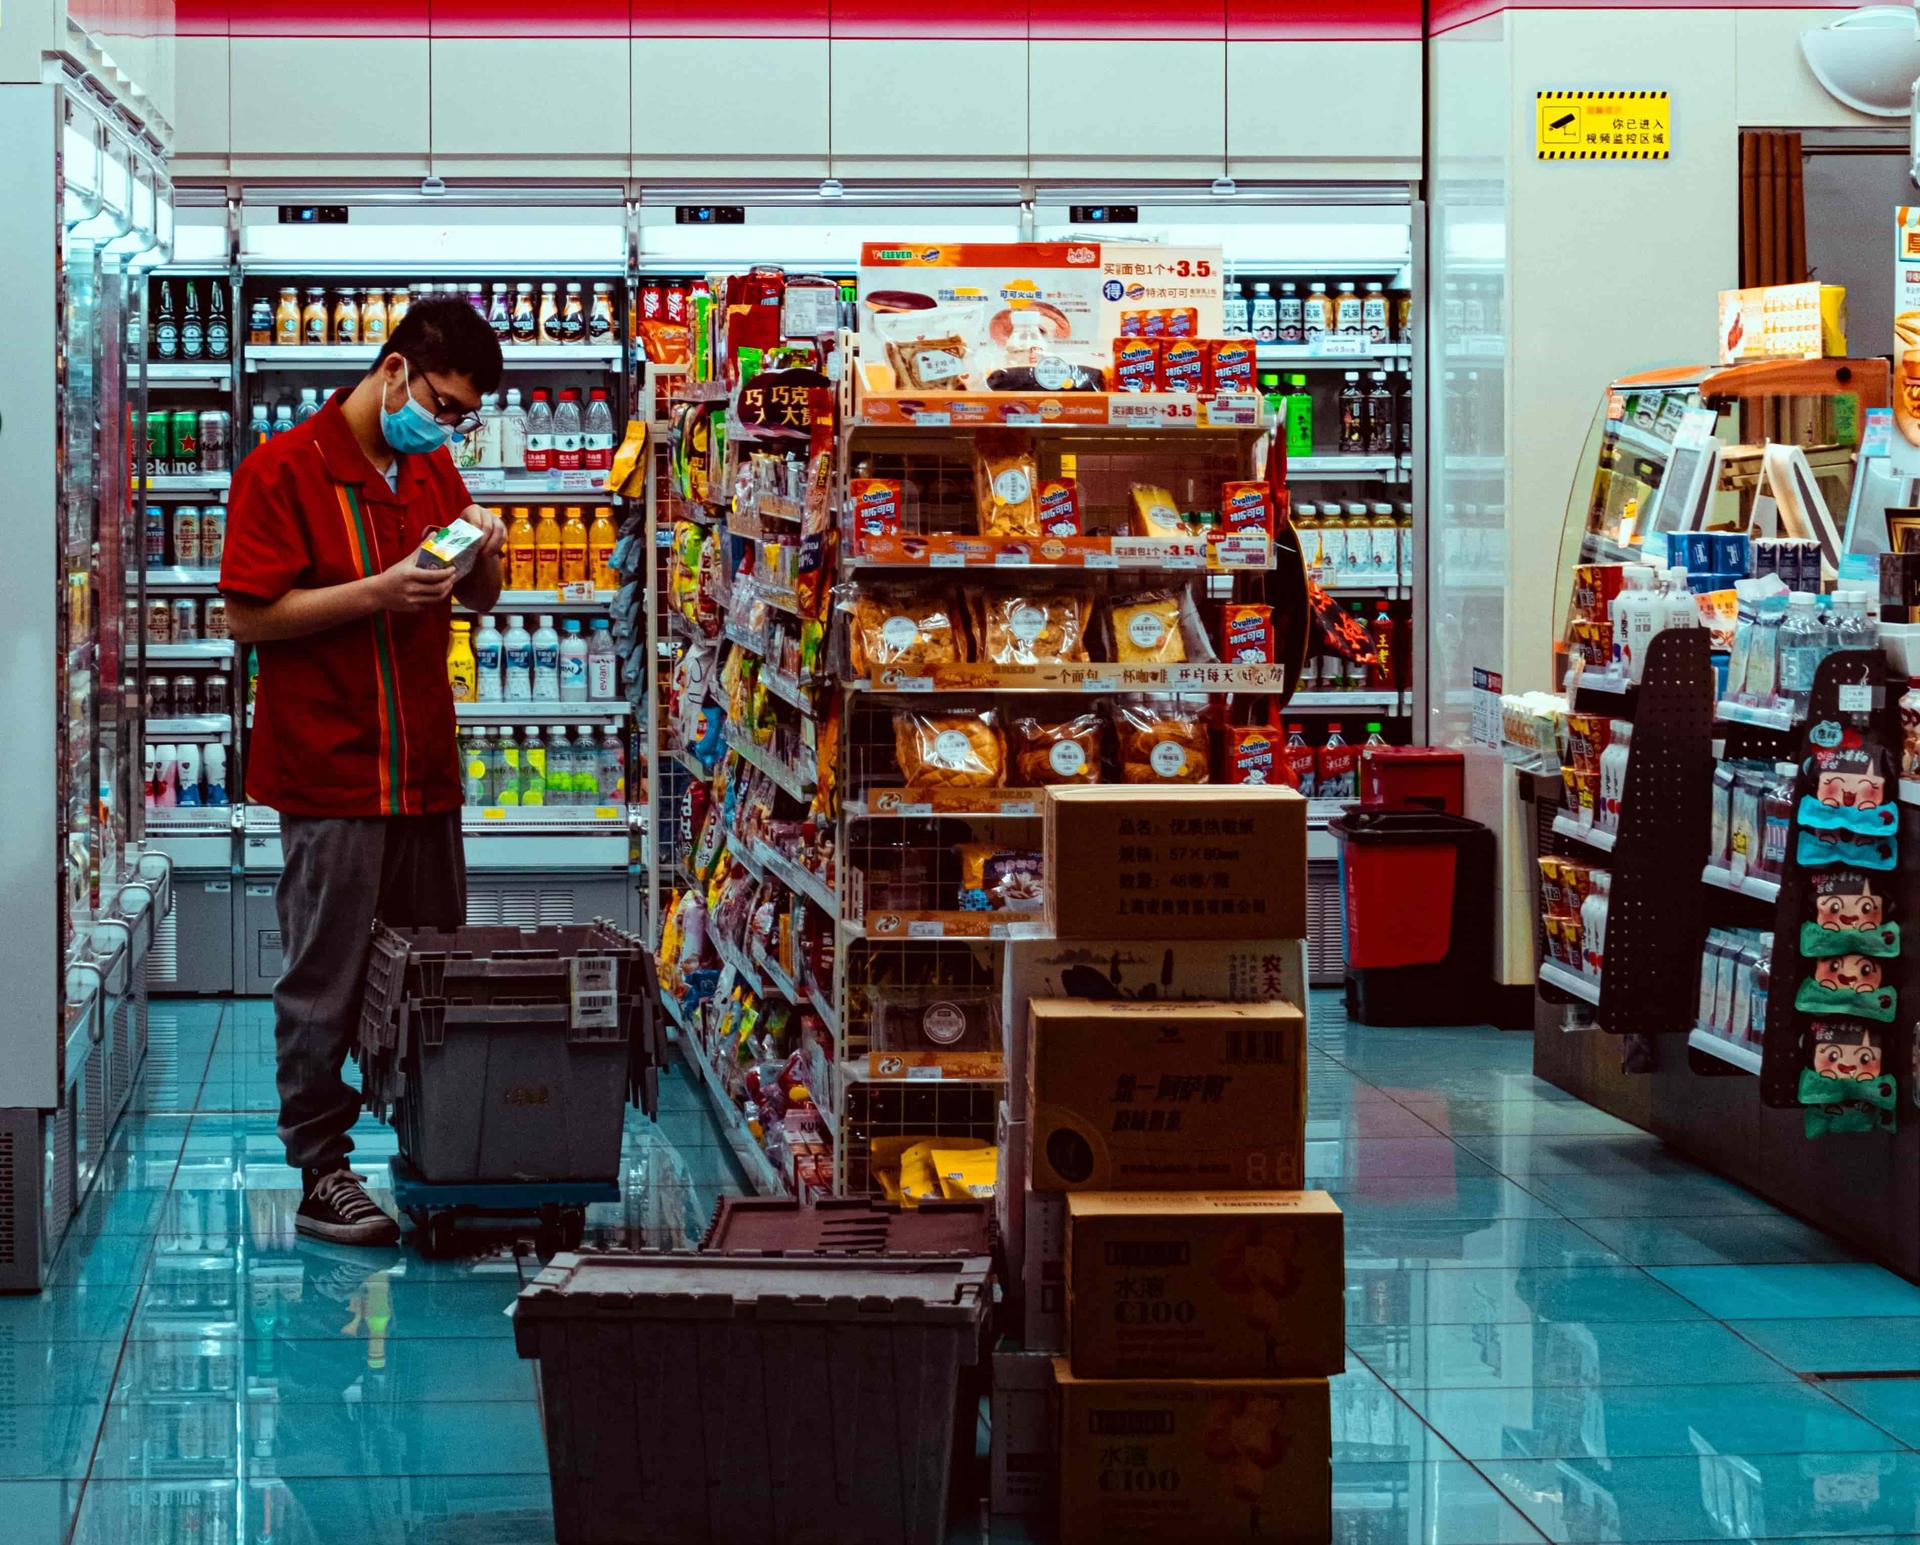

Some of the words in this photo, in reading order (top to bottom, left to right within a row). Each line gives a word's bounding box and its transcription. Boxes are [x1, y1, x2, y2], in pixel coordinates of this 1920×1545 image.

[1612, 119, 1664, 130] 你已进入
[1586, 133, 1664, 144] 视频监控区域
[1104, 282, 1122, 299] 得
[1121, 348, 1152, 360] Ovaltine
[1167, 348, 1200, 361] Ovaltine
[1217, 350, 1249, 362] Ovaltine
[862, 490, 893, 502] Ovaltine
[1040, 489, 1069, 504] Ovaltine
[1231, 492, 1263, 507] Ovaltine
[1231, 616, 1264, 629] Ovaltine
[599, 665, 608, 691] evian
[1179, 667, 1234, 684] 开启每天
[1239, 740, 1270, 754] Ovaltine
[1262, 954, 1282, 999] 农夫
[1114, 1300, 1196, 1324] C100
[1098, 1469, 1182, 1492] C100
